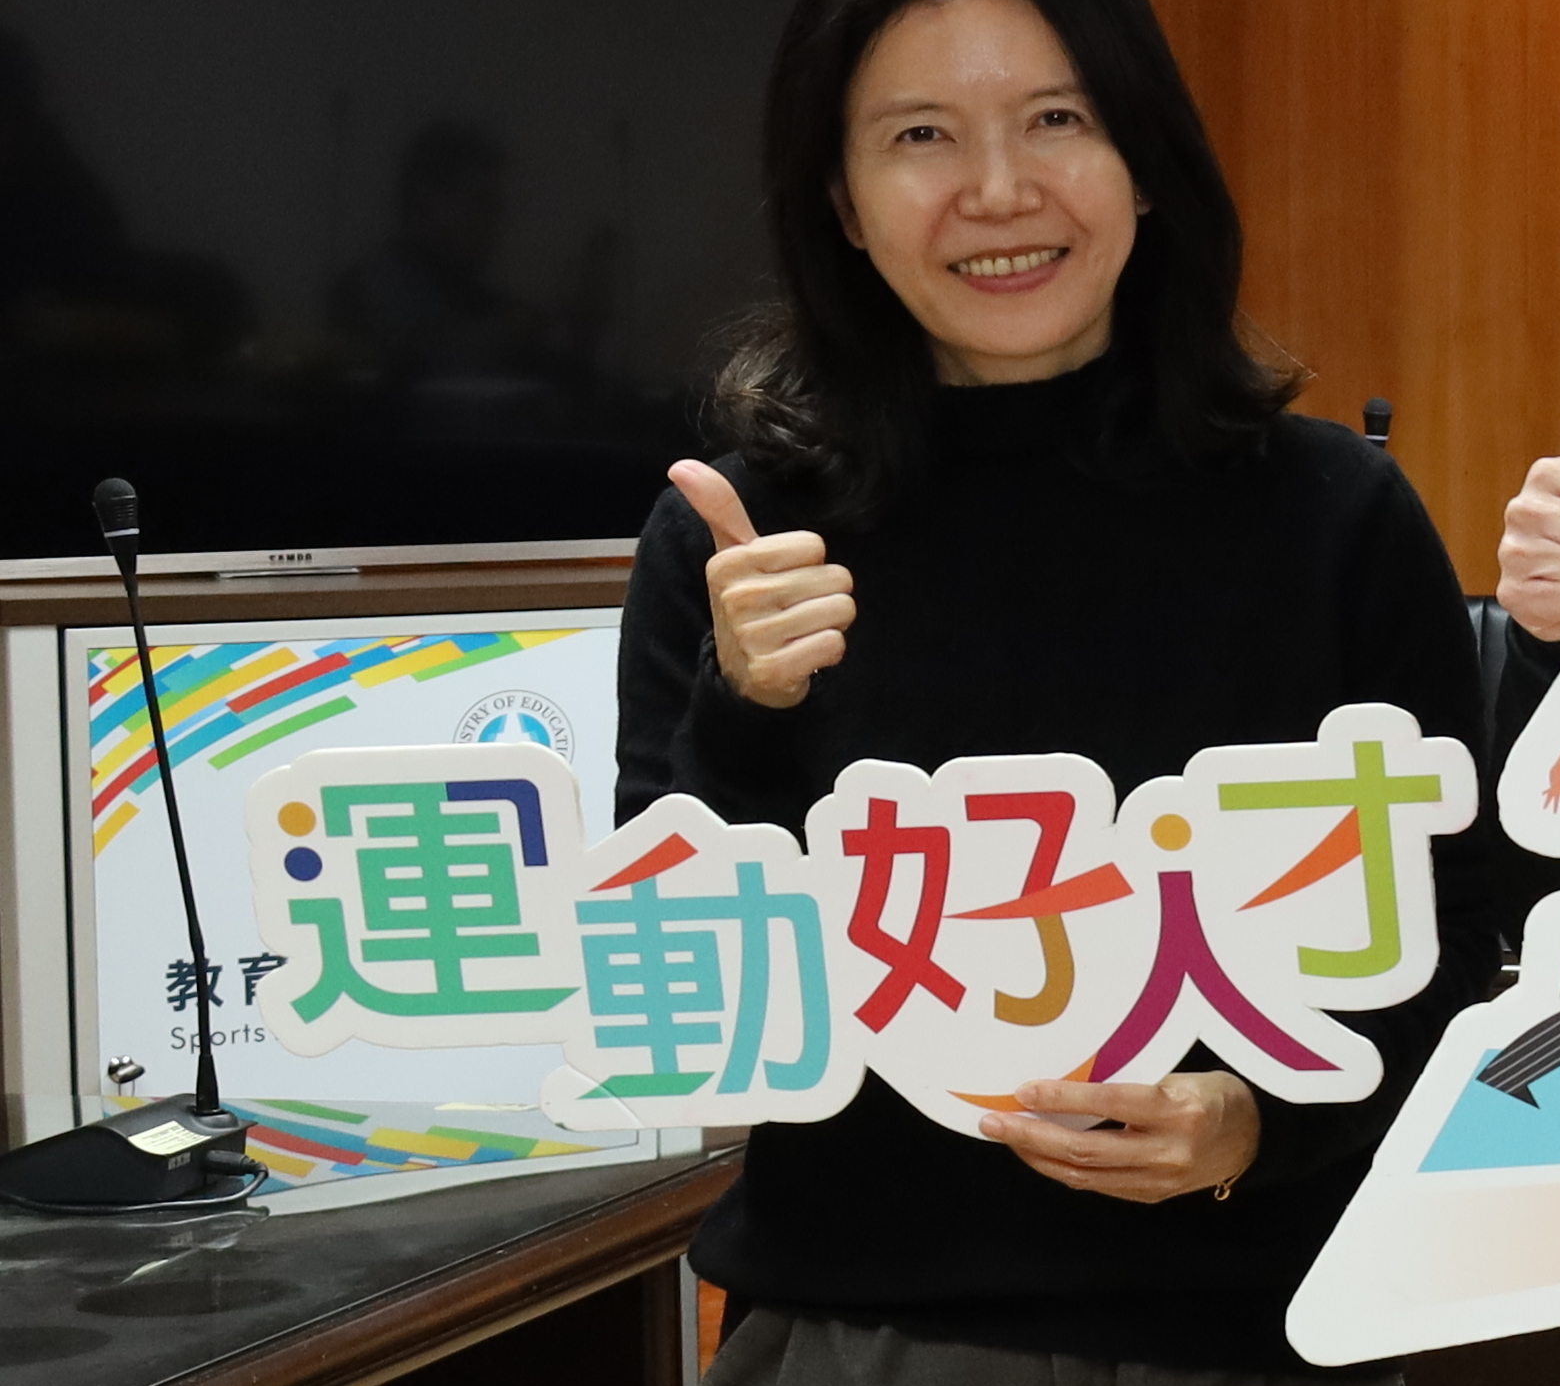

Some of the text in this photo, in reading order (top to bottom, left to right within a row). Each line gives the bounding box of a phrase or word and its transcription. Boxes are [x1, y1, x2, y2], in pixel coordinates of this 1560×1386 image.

[493, 695, 516, 709] OF
[276, 739, 1443, 1103] 運動好人才
[170, 1025, 266, 1054] Sports
